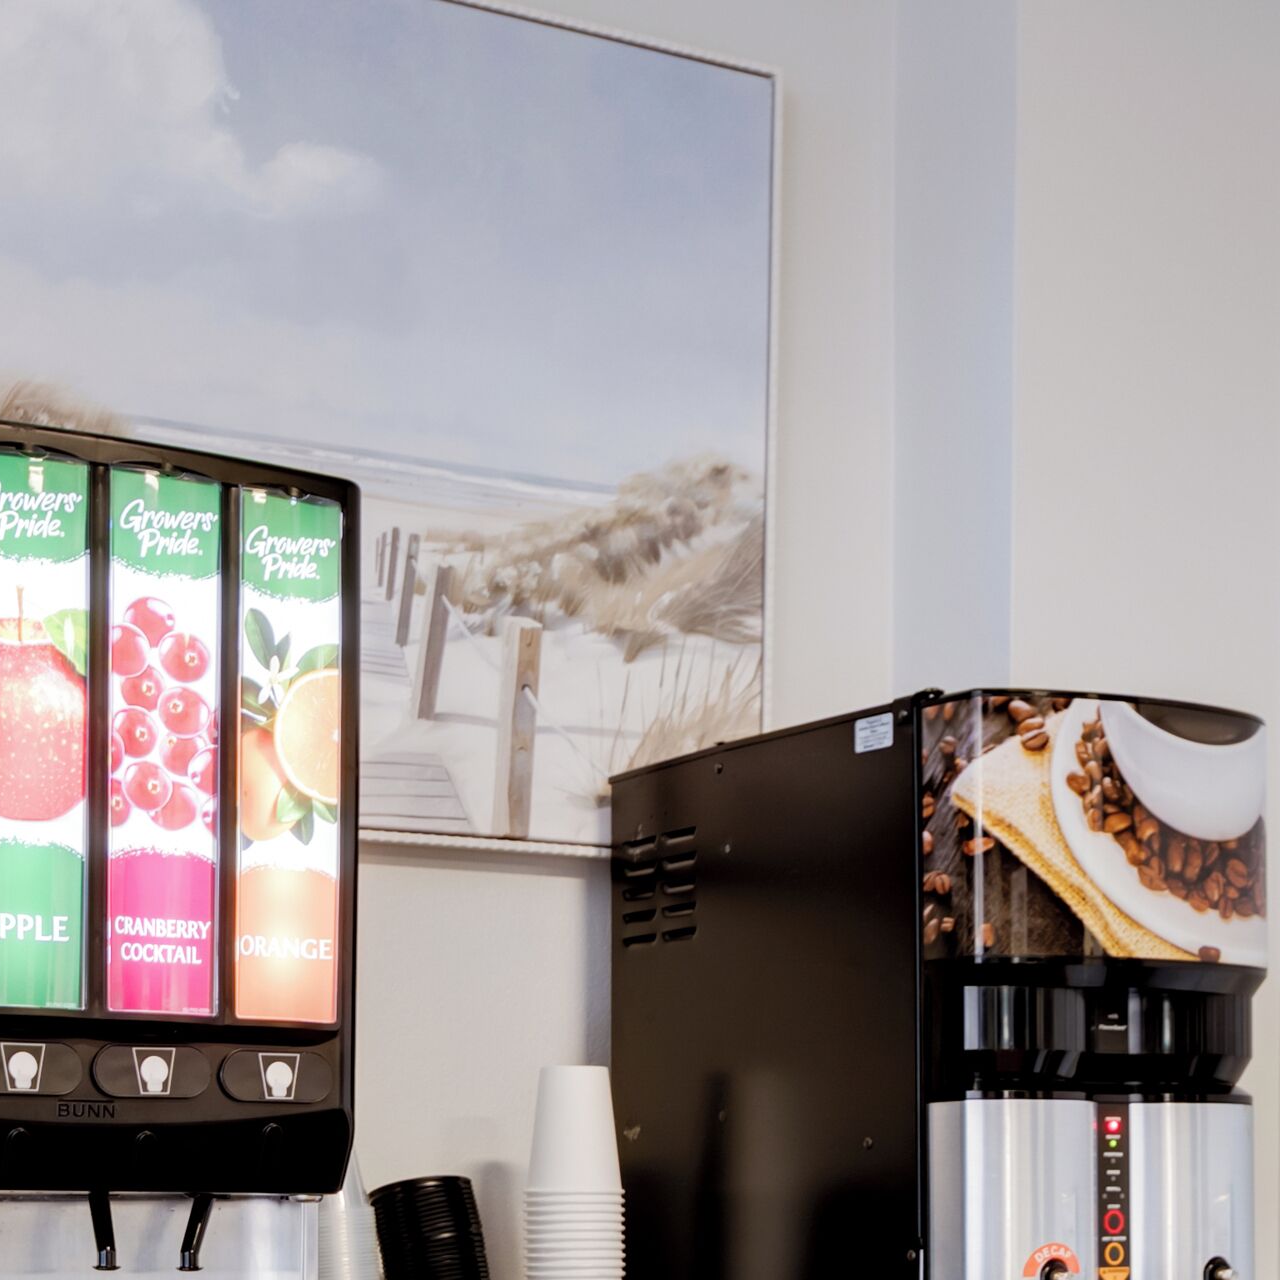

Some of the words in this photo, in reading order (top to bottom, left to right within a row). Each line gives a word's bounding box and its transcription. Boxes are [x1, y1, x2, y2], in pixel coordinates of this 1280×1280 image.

[114, 915, 211, 940] CRANBERRY
[120, 942, 203, 965] COCKTAIL
[239, 934, 334, 961] ORANGE
[57, 1103, 116, 1119] BUNN
